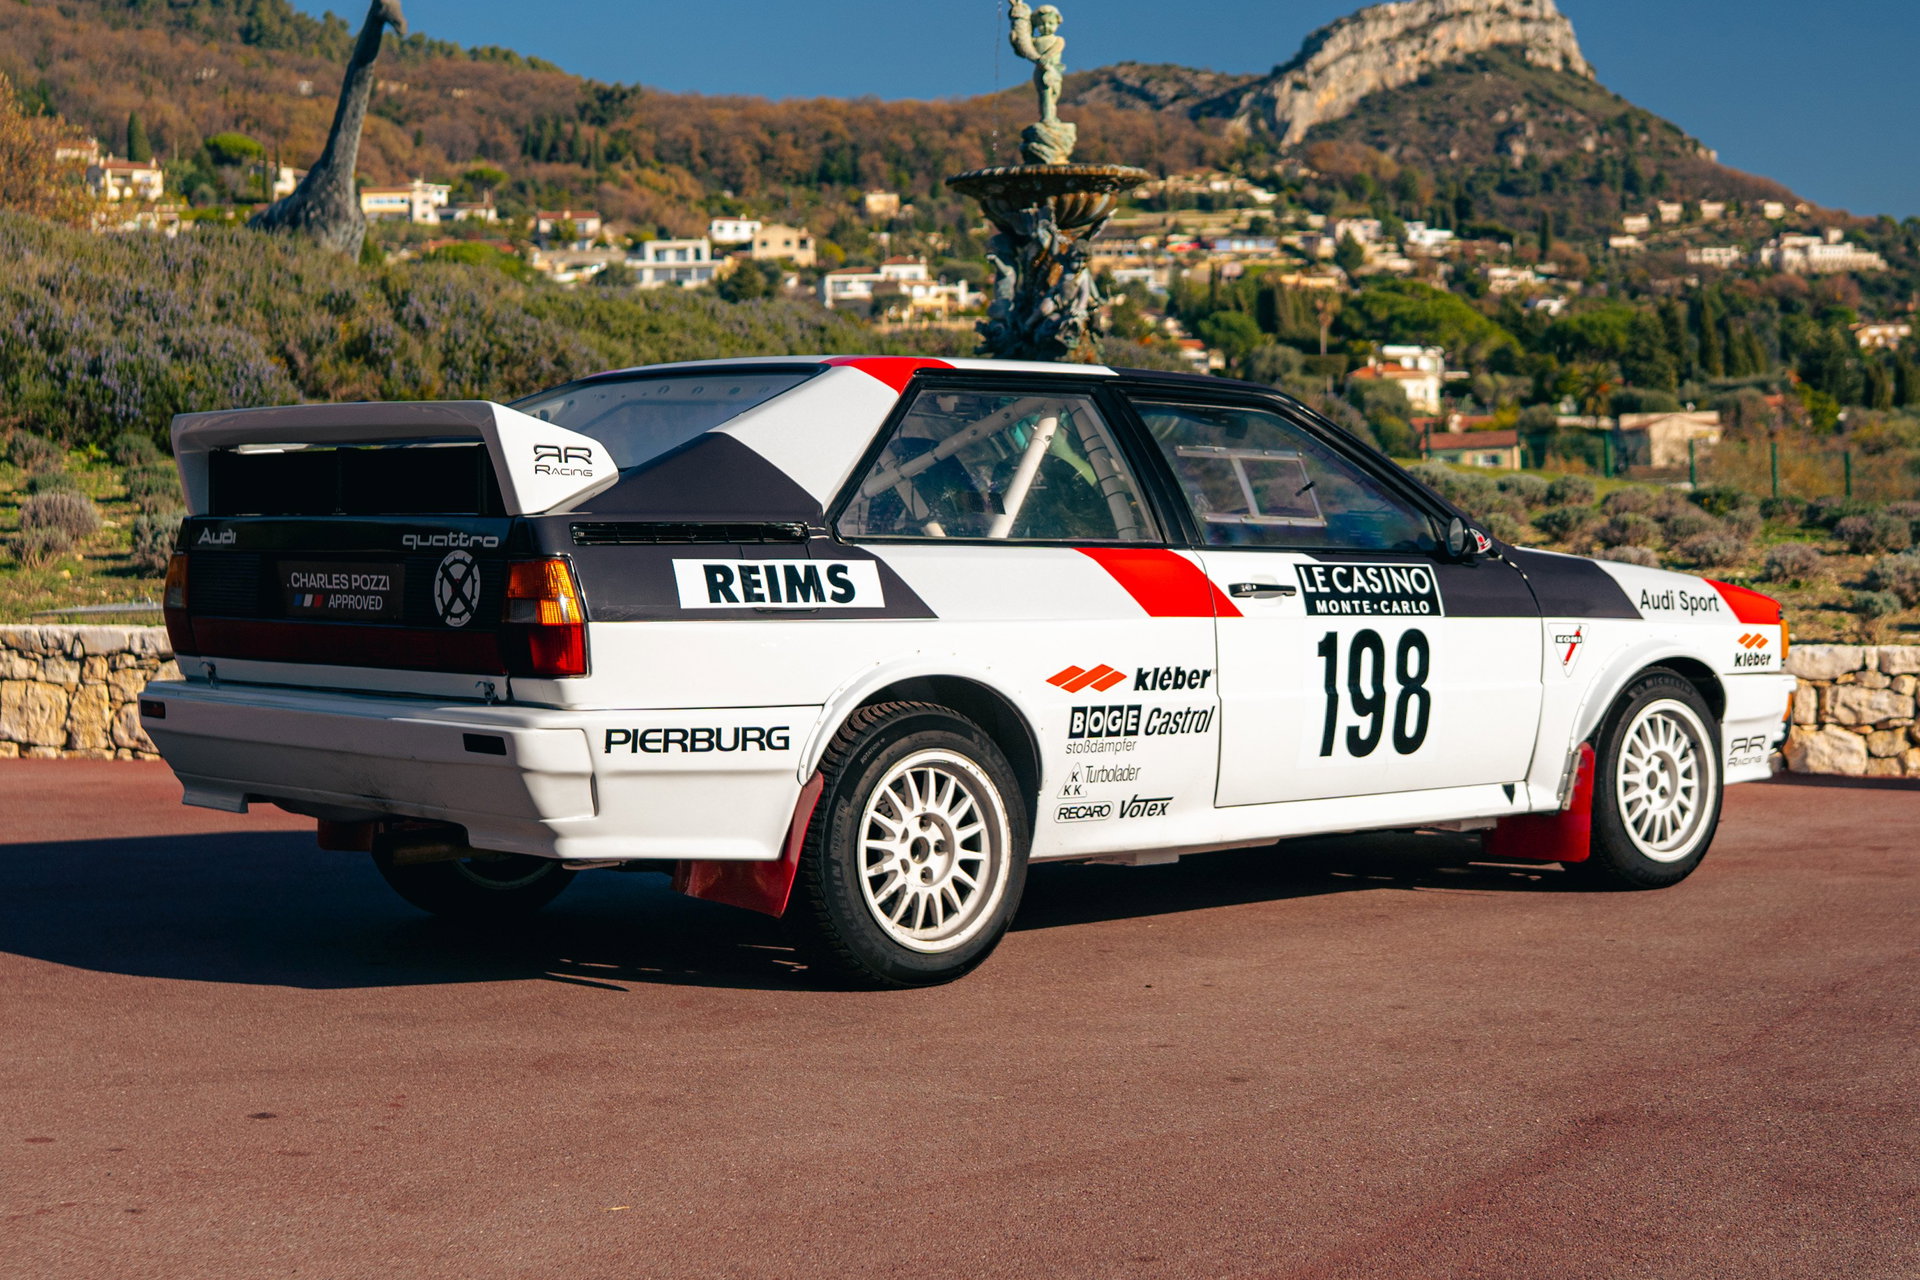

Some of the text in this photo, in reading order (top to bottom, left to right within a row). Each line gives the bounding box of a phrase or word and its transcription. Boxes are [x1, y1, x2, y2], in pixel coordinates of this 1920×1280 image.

[197, 527, 237, 545] Audi
[402, 532, 499, 550] quattro
[291, 572, 390, 591] CHARLES POZZI
[703, 564, 856, 604] REIMS
[1299, 566, 1431, 595] LE CASINO
[328, 593, 383, 611] APPROVED
[1640, 588, 1720, 616] Audi Sport
[1317, 628, 1431, 758] 198
[1071, 708, 1141, 736] BOGE
[1144, 705, 1216, 736] Castrol
[604, 726, 790, 754] PIERBURG
[1085, 764, 1141, 783] Turbolader
[1058, 805, 1111, 820] RECARO
